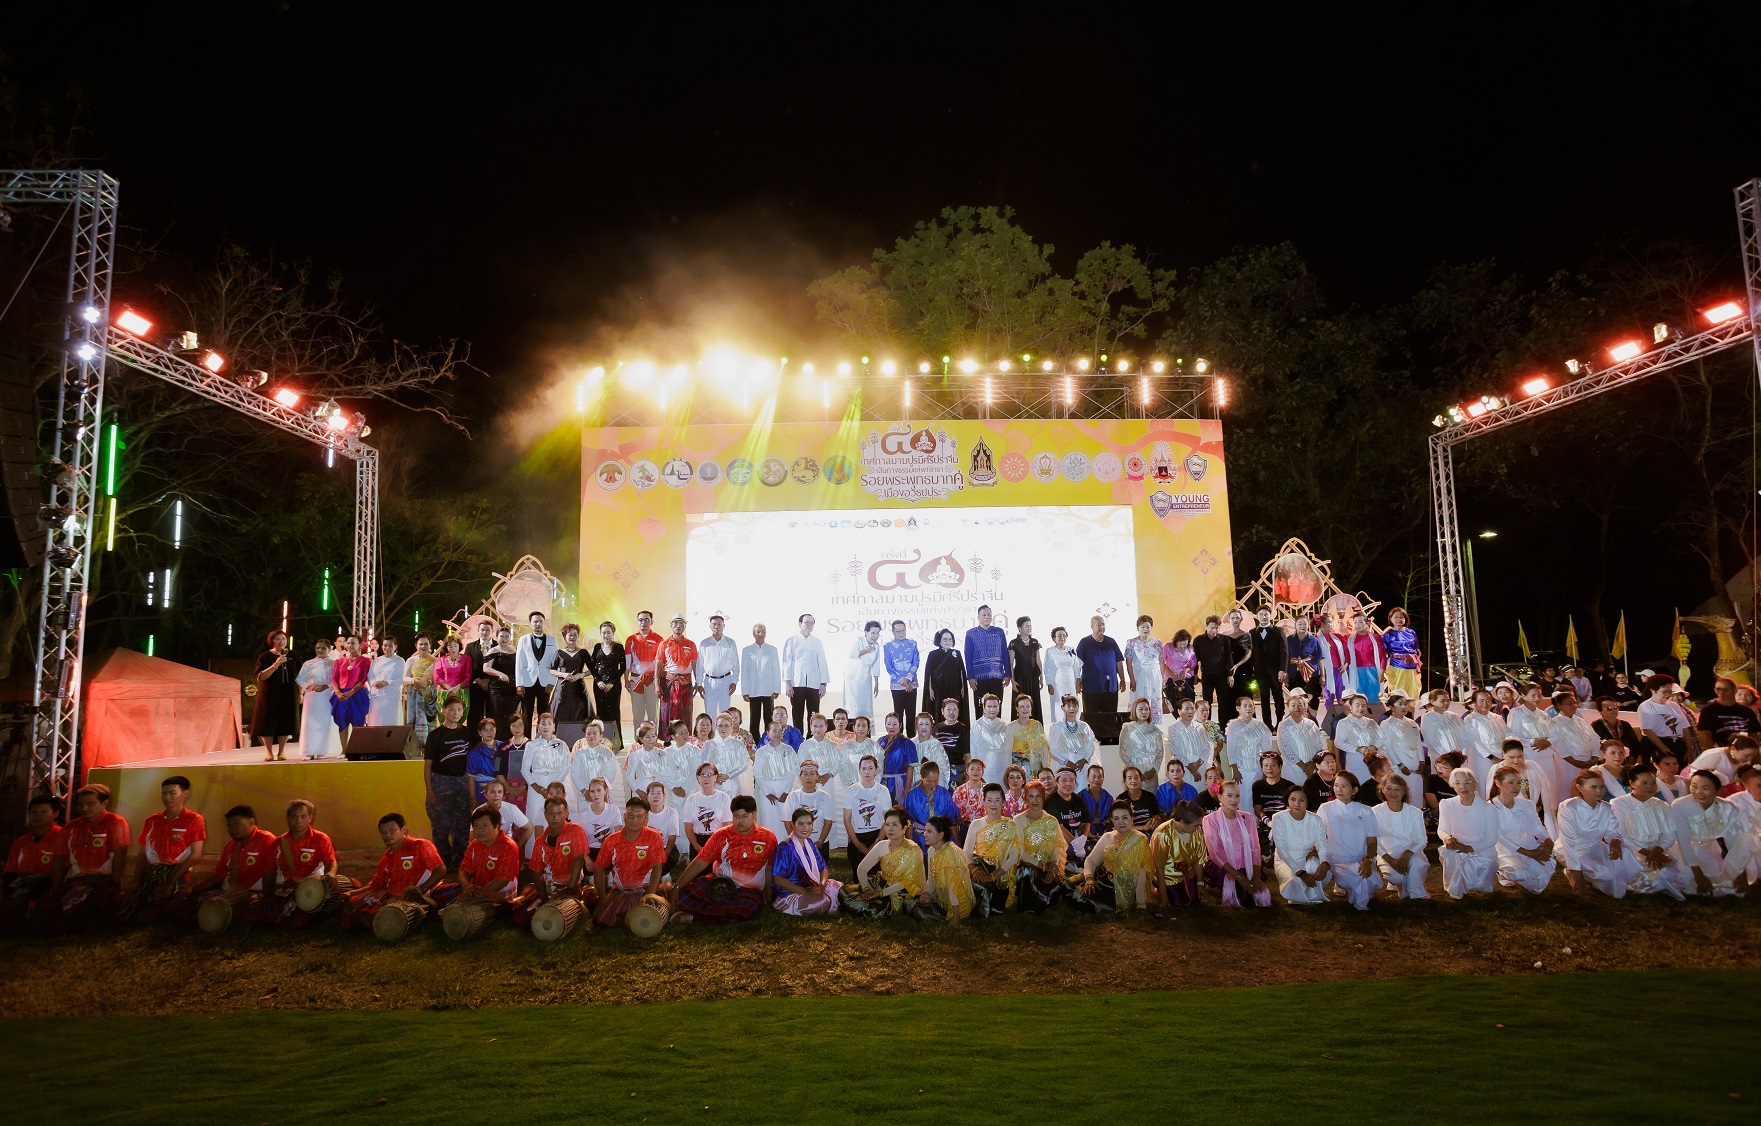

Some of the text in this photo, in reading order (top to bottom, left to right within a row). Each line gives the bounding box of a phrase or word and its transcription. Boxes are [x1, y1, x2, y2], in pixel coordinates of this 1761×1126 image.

[860, 470, 964, 491] รอยพระพุทธบาทคู่
[1173, 494, 1209, 502] YOUNG
